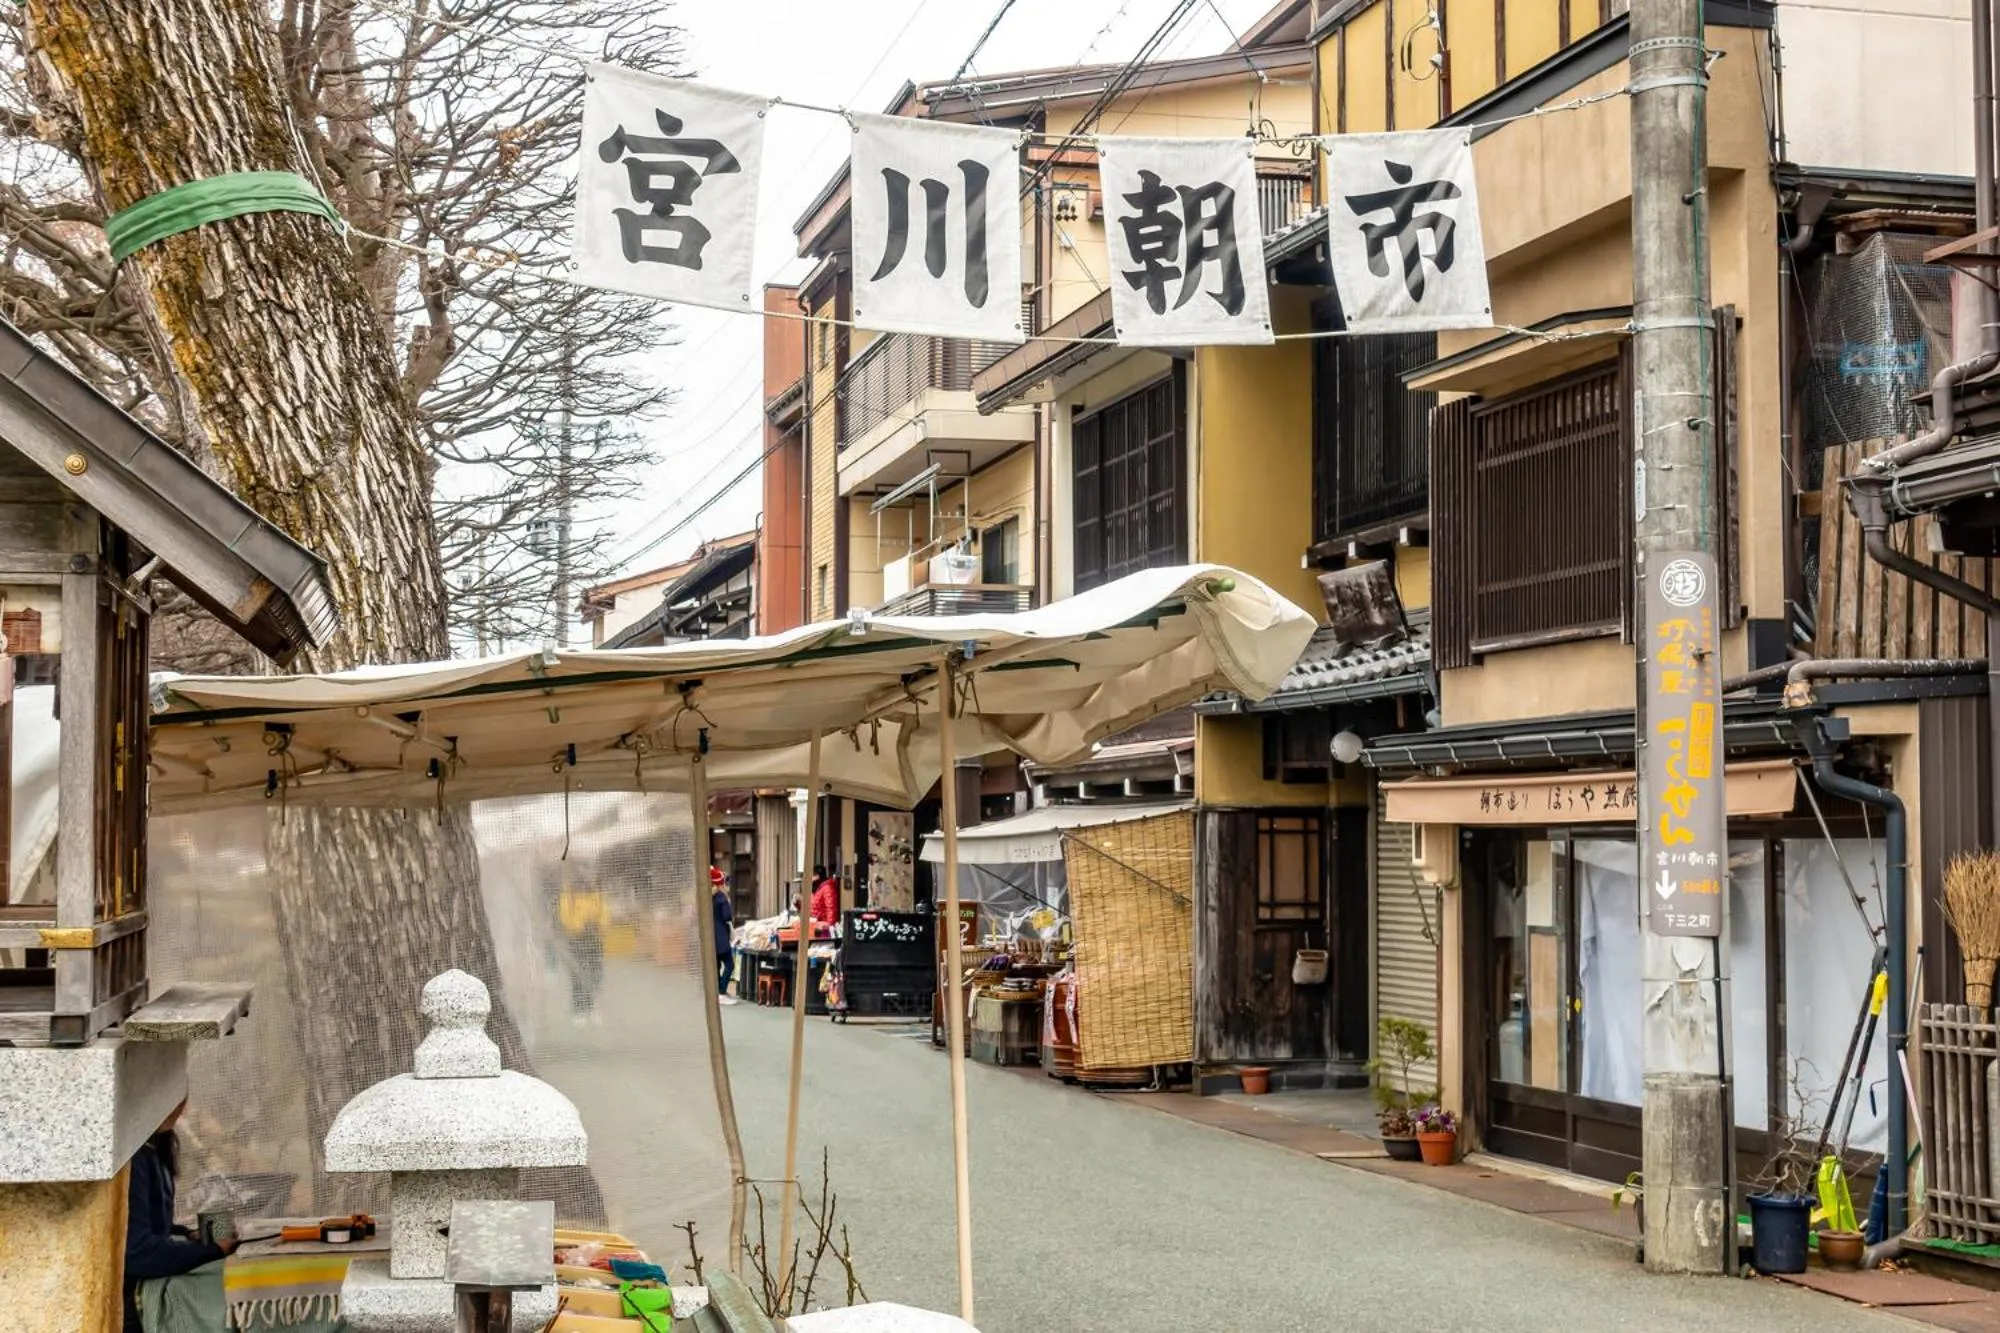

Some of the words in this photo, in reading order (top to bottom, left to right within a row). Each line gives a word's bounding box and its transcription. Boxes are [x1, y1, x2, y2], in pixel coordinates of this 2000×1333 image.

[1656, 851, 1719, 867] 宮川朝市
[1665, 914, 1712, 928] 下三之町
